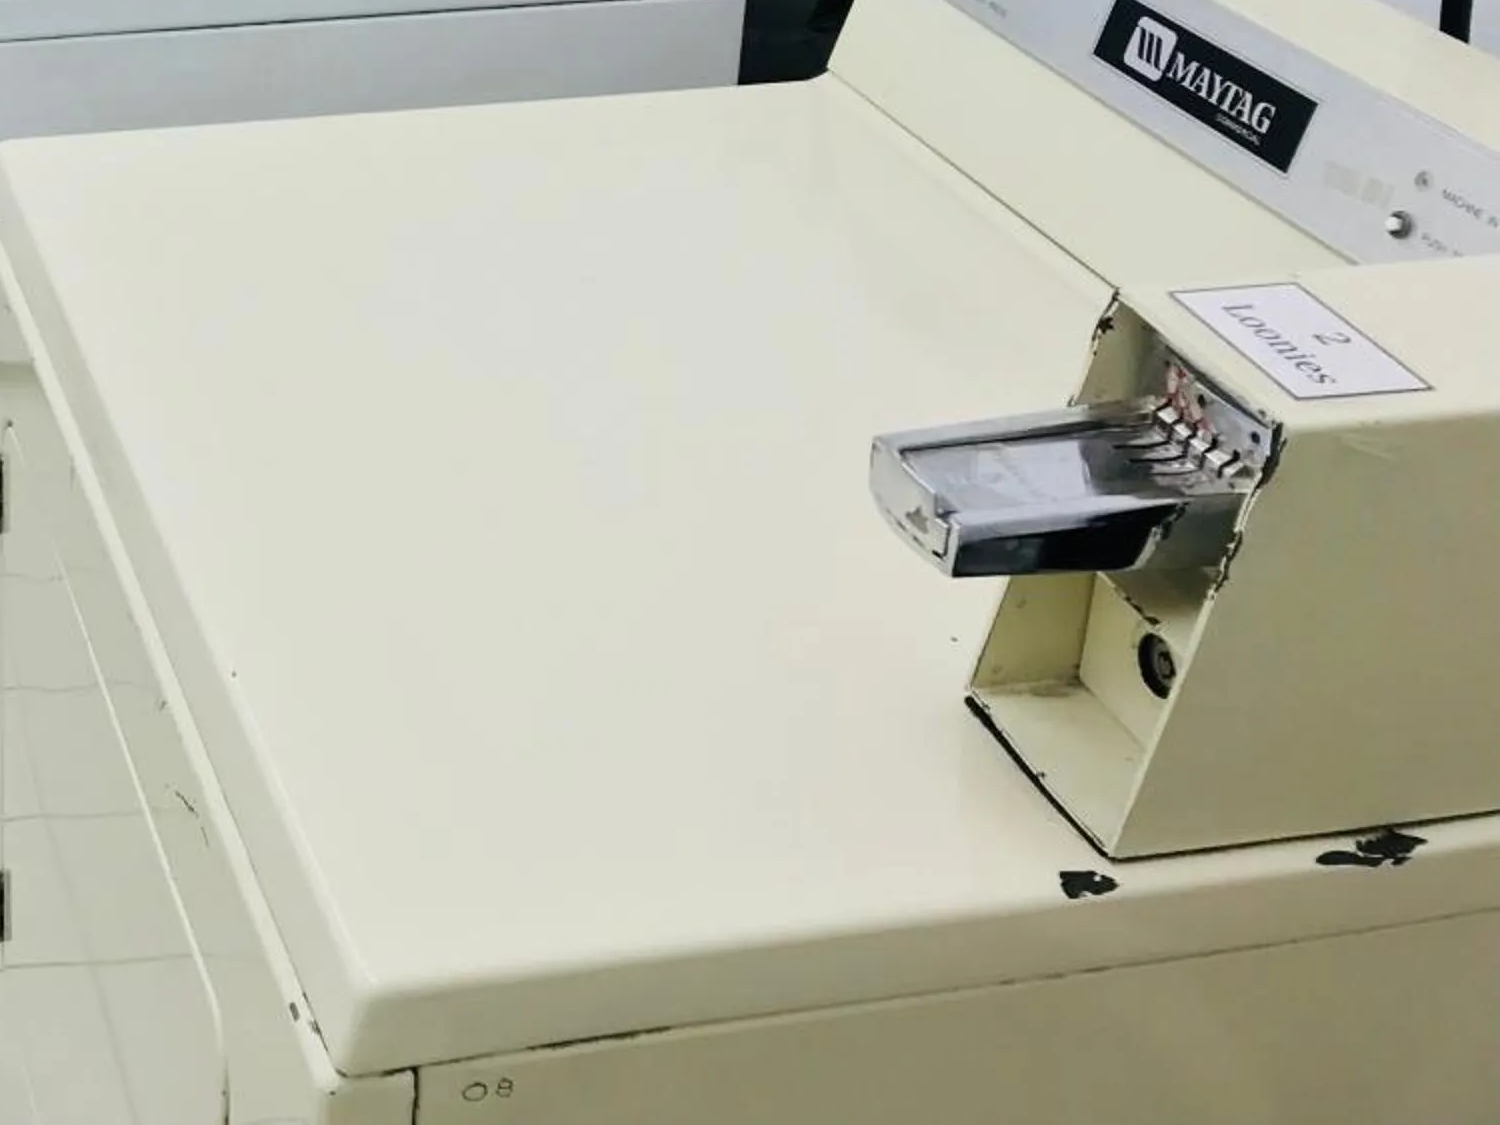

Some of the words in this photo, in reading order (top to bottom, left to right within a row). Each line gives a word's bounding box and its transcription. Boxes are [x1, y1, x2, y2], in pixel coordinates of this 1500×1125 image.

[1166, 50, 1277, 134] MAYTAG
[1222, 303, 1338, 385] Loonies
[1311, 330, 1352, 346] 2
